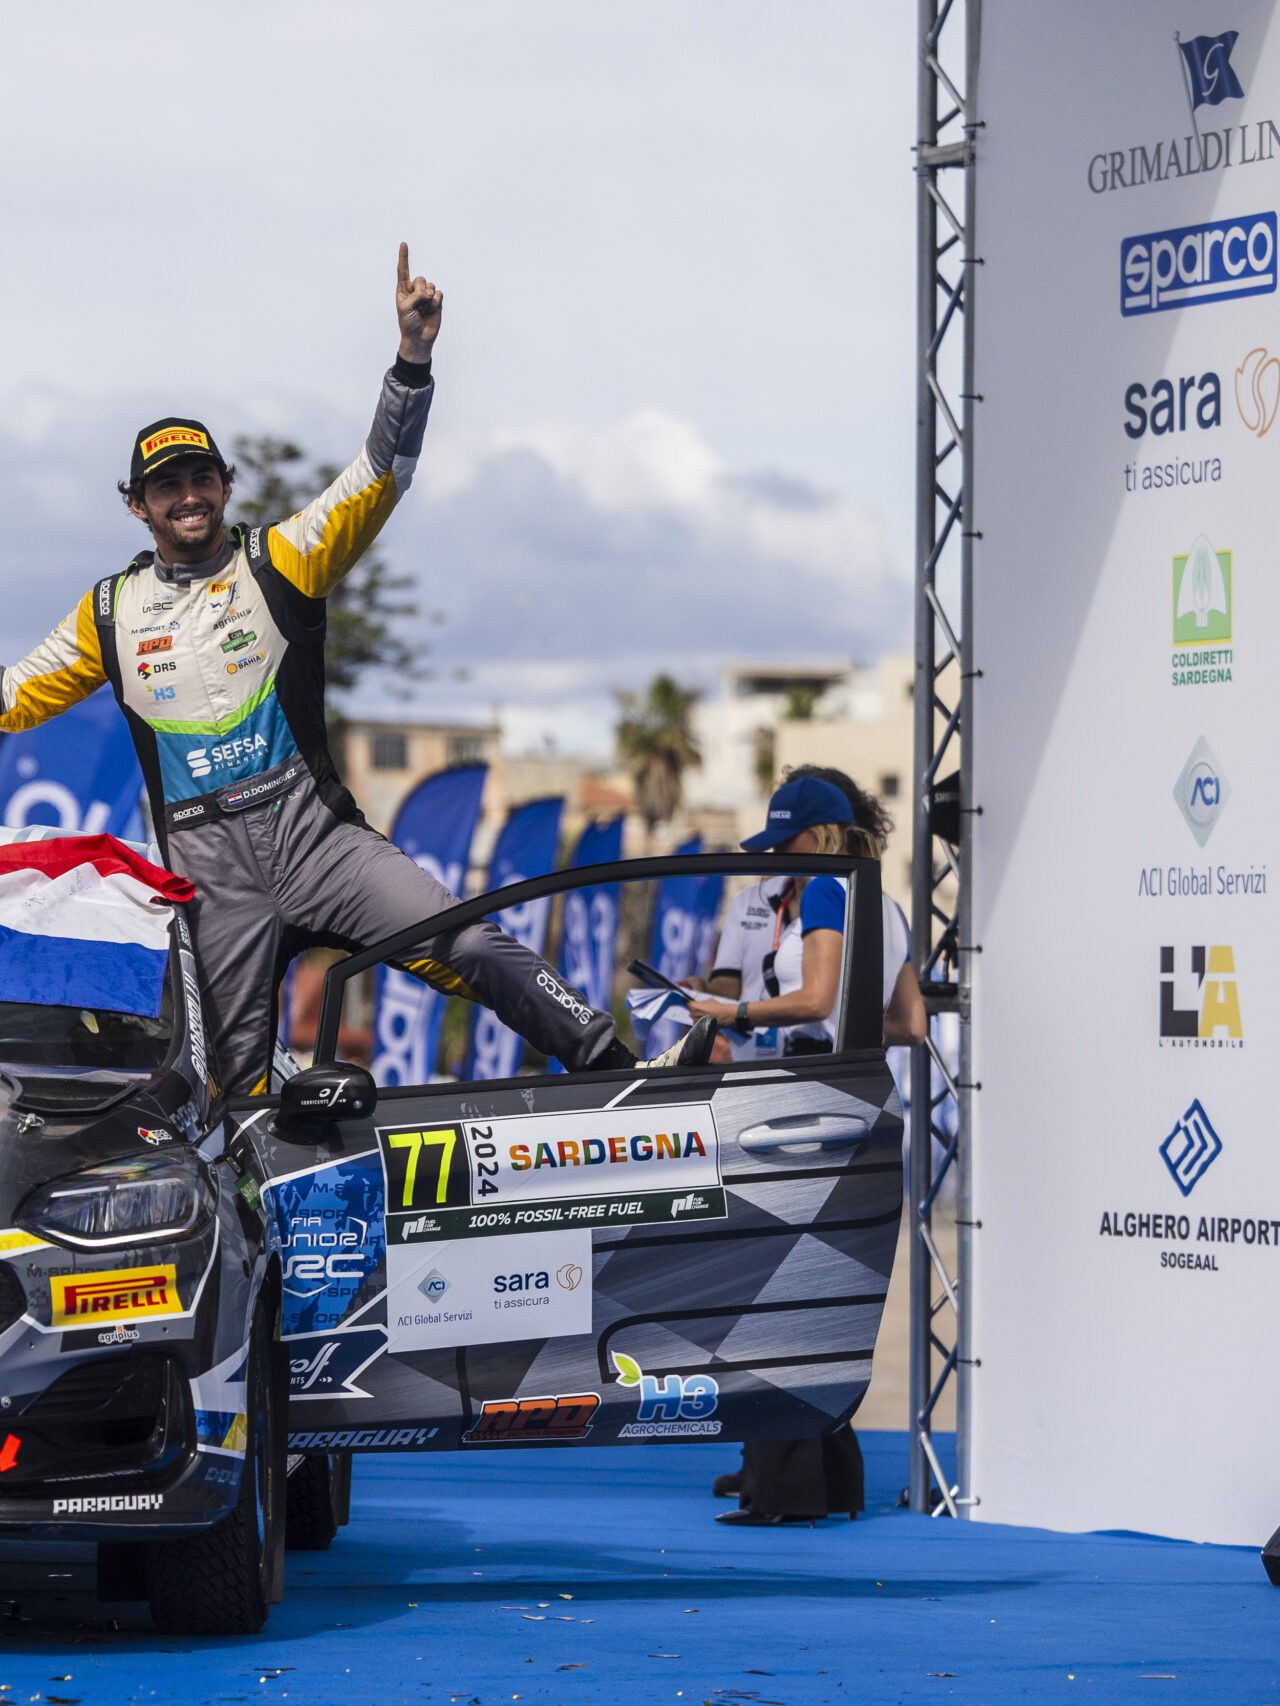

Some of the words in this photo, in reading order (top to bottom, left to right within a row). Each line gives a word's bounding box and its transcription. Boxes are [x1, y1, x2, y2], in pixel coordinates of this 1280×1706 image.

[1087, 128, 1233, 194] GRIMALDI
[1125, 221, 1273, 309] sparco
[1123, 371, 1222, 440] sara
[146, 429, 203, 454] PIRELLI
[1124, 463, 1137, 492] ti
[1142, 455, 1222, 490] assicura
[100, 579, 111, 615] sparco
[131, 625, 166, 635] M-SPORT
[213, 608, 252, 630] agriplus
[139, 636, 172, 652] RPD
[153, 661, 177, 674] DRS
[238, 655, 261, 669] BAHIA
[1172, 649, 1233, 668] COLDIRETTI
[1172, 668, 1233, 687] SARDEGNA
[153, 685, 176, 702] H3
[211, 733, 268, 763] SEFSA
[1190, 776, 1221, 806] ACI
[173, 805, 204, 820] sparco
[1139, 868, 1163, 897] ACI
[1167, 866, 1213, 896] Global
[1216, 864, 1267, 895] Servizi
[537, 971, 593, 1024] sparco
[1159, 1039, 1244, 1048] L'AUTOMOBILE
[471, 1126, 499, 1196] 2024
[509, 1131, 706, 1171] SARDEGNA
[388, 1129, 456, 1207] 77
[291, 1217, 322, 1228] FIA
[469, 1212, 511, 1229] 100%
[515, 1204, 605, 1224] FOSSIL-FREE
[607, 1201, 644, 1216] FUEL
[281, 1232, 358, 1247] UNIOR
[1099, 1211, 1190, 1241] ALGHERO
[1196, 1216, 1280, 1246] AIRPORT
[1160, 1251, 1219, 1271] SOGEAAL
[427, 1281, 446, 1292] ACI
[493, 1271, 549, 1293] sara
[64, 1275, 168, 1316] PIRELLI
[494, 1299, 502, 1309] ti
[504, 1296, 550, 1309] assicura
[397, 1316, 412, 1327] ACI
[414, 1313, 441, 1325] Global
[443, 1310, 473, 1322] Servizi
[98, 1330, 139, 1343] agriplus
[290, 1343, 341, 1389] olf
[638, 1375, 719, 1420] H3
[478, 1395, 598, 1431] RPD
[288, 1428, 439, 1448] ARAGUAY
[622, 1421, 721, 1435] AGROCHEMICALS
[53, 1493, 163, 1513] PARAGUAY
